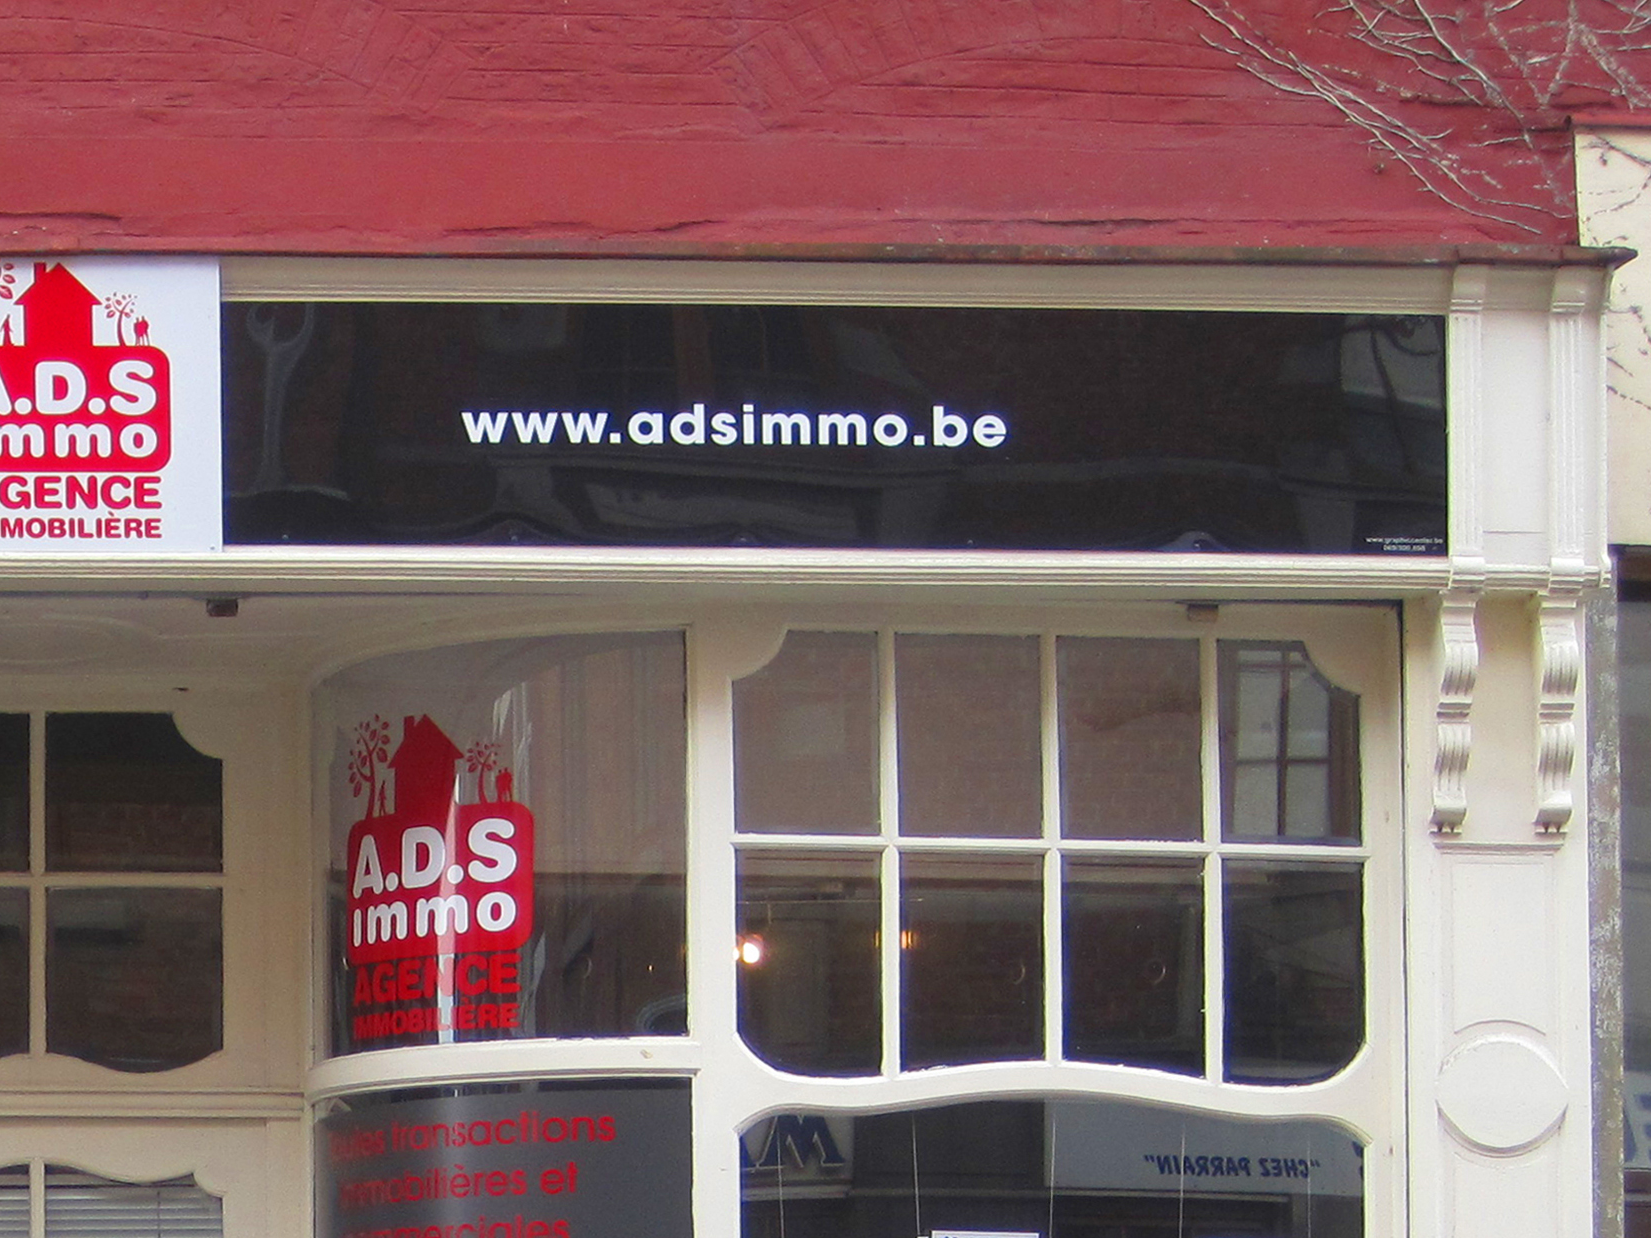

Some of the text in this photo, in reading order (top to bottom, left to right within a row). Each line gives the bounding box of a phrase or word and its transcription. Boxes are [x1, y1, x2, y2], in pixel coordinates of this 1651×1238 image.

[461, 403, 1008, 447] www.adsimmo.be
[352, 817, 518, 899] A.D.S
[353, 891, 517, 947] immo
[353, 953, 522, 1007] AGENCE
[353, 998, 521, 1041] IMMOBILIÈRE
[392, 1111, 616, 1150] transactions
[540, 1162, 578, 1195] et
